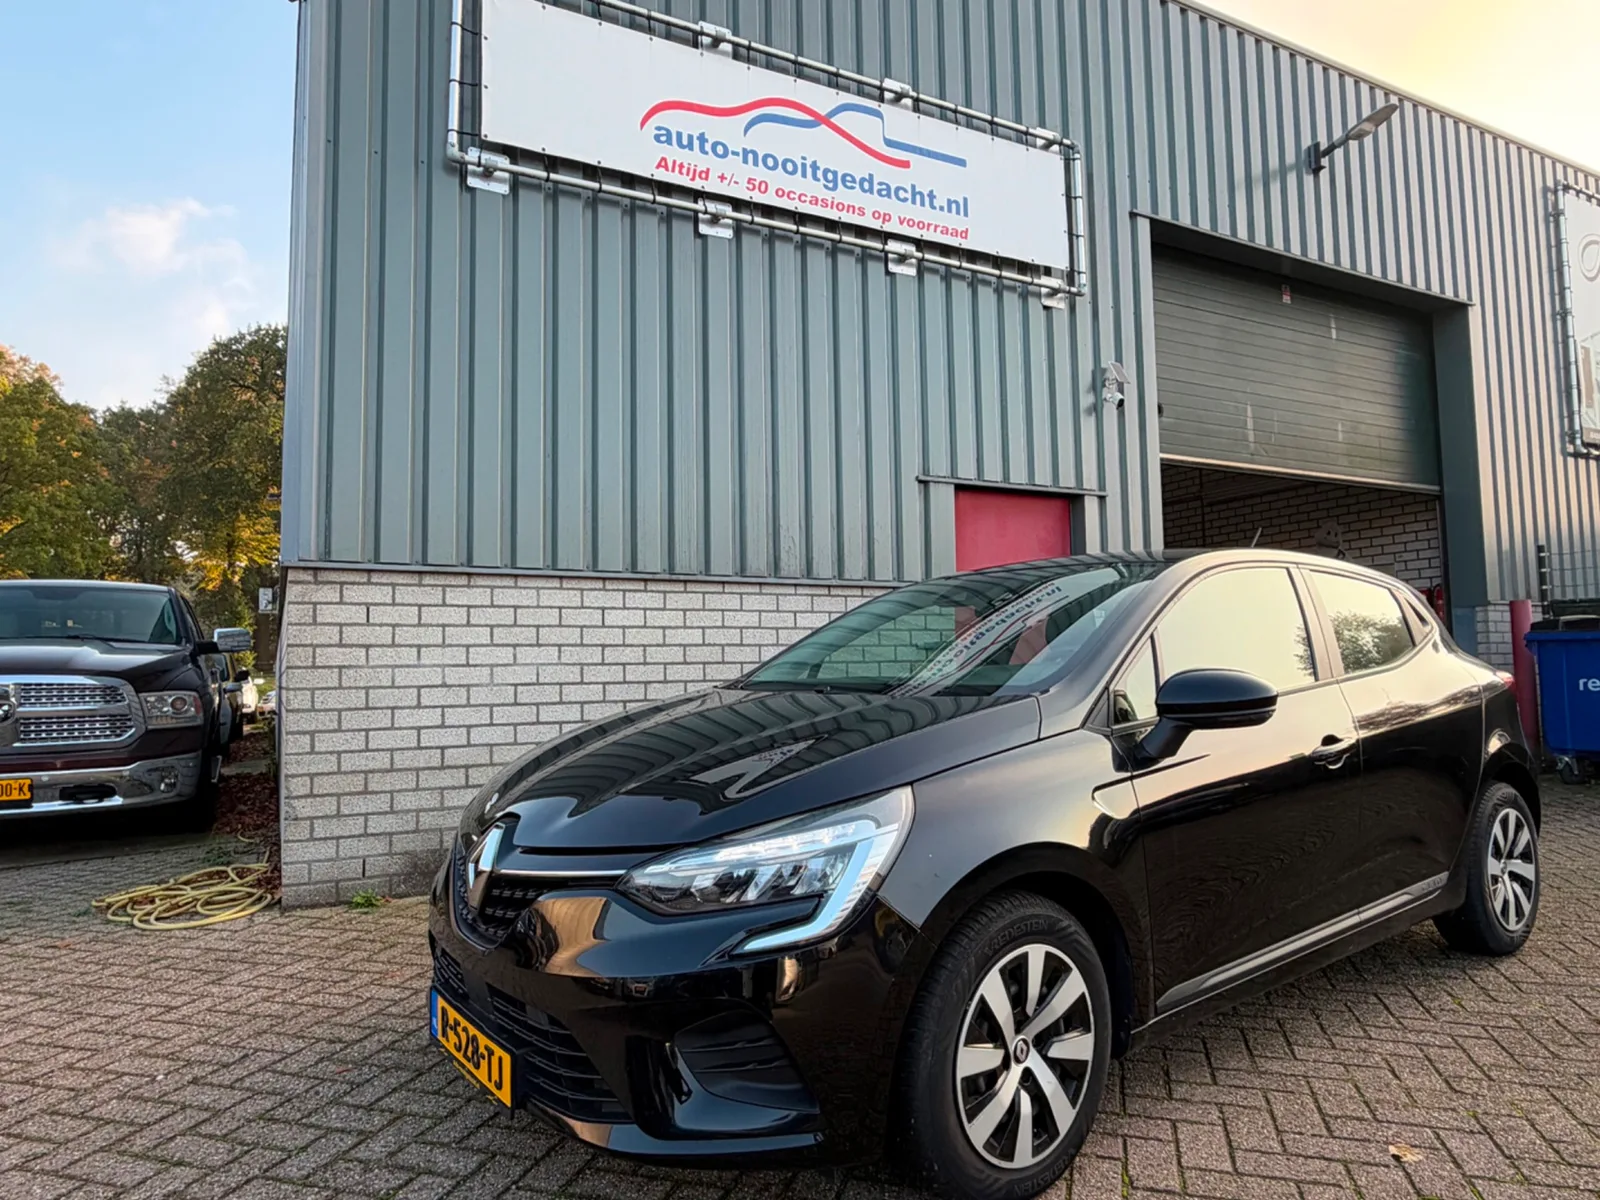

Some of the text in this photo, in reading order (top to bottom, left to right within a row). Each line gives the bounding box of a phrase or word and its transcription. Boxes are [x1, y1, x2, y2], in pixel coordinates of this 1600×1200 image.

[653, 125, 969, 218] auto-nooitgedacht.nl
[655, 156, 969, 240] Altijd +/- 50 occasions op voorraad
[1579, 678, 1600, 691] re
[984, 919, 1049, 957] VREDESTEIN
[441, 1005, 503, 1091] R-528-TJ
